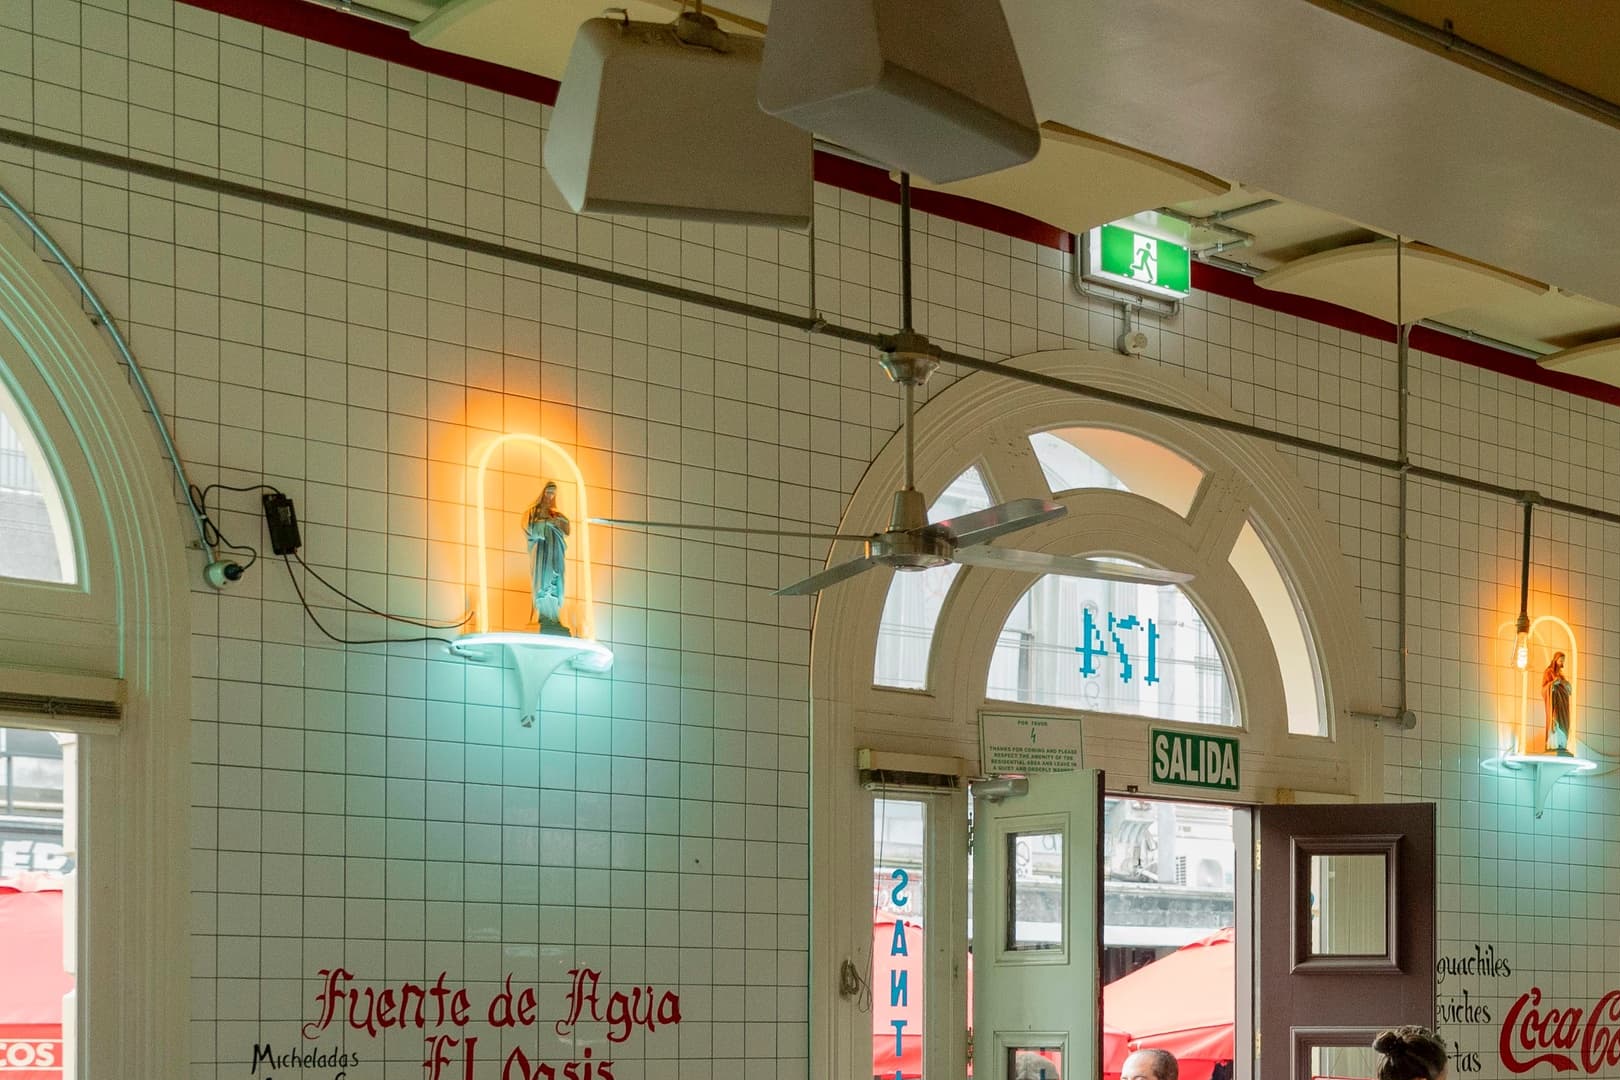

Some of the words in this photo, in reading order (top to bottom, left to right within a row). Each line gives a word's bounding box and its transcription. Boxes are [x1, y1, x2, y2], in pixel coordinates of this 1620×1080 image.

[1154, 734, 1237, 786] SALIDA
[1436, 943, 1512, 985] guachiles
[302, 967, 472, 1040] Fuente
[487, 971, 538, 1028] de
[555, 967, 683, 1043] Agua
[251, 1043, 360, 1076] Micheladas
[1448, 1040, 1482, 1073] tas
